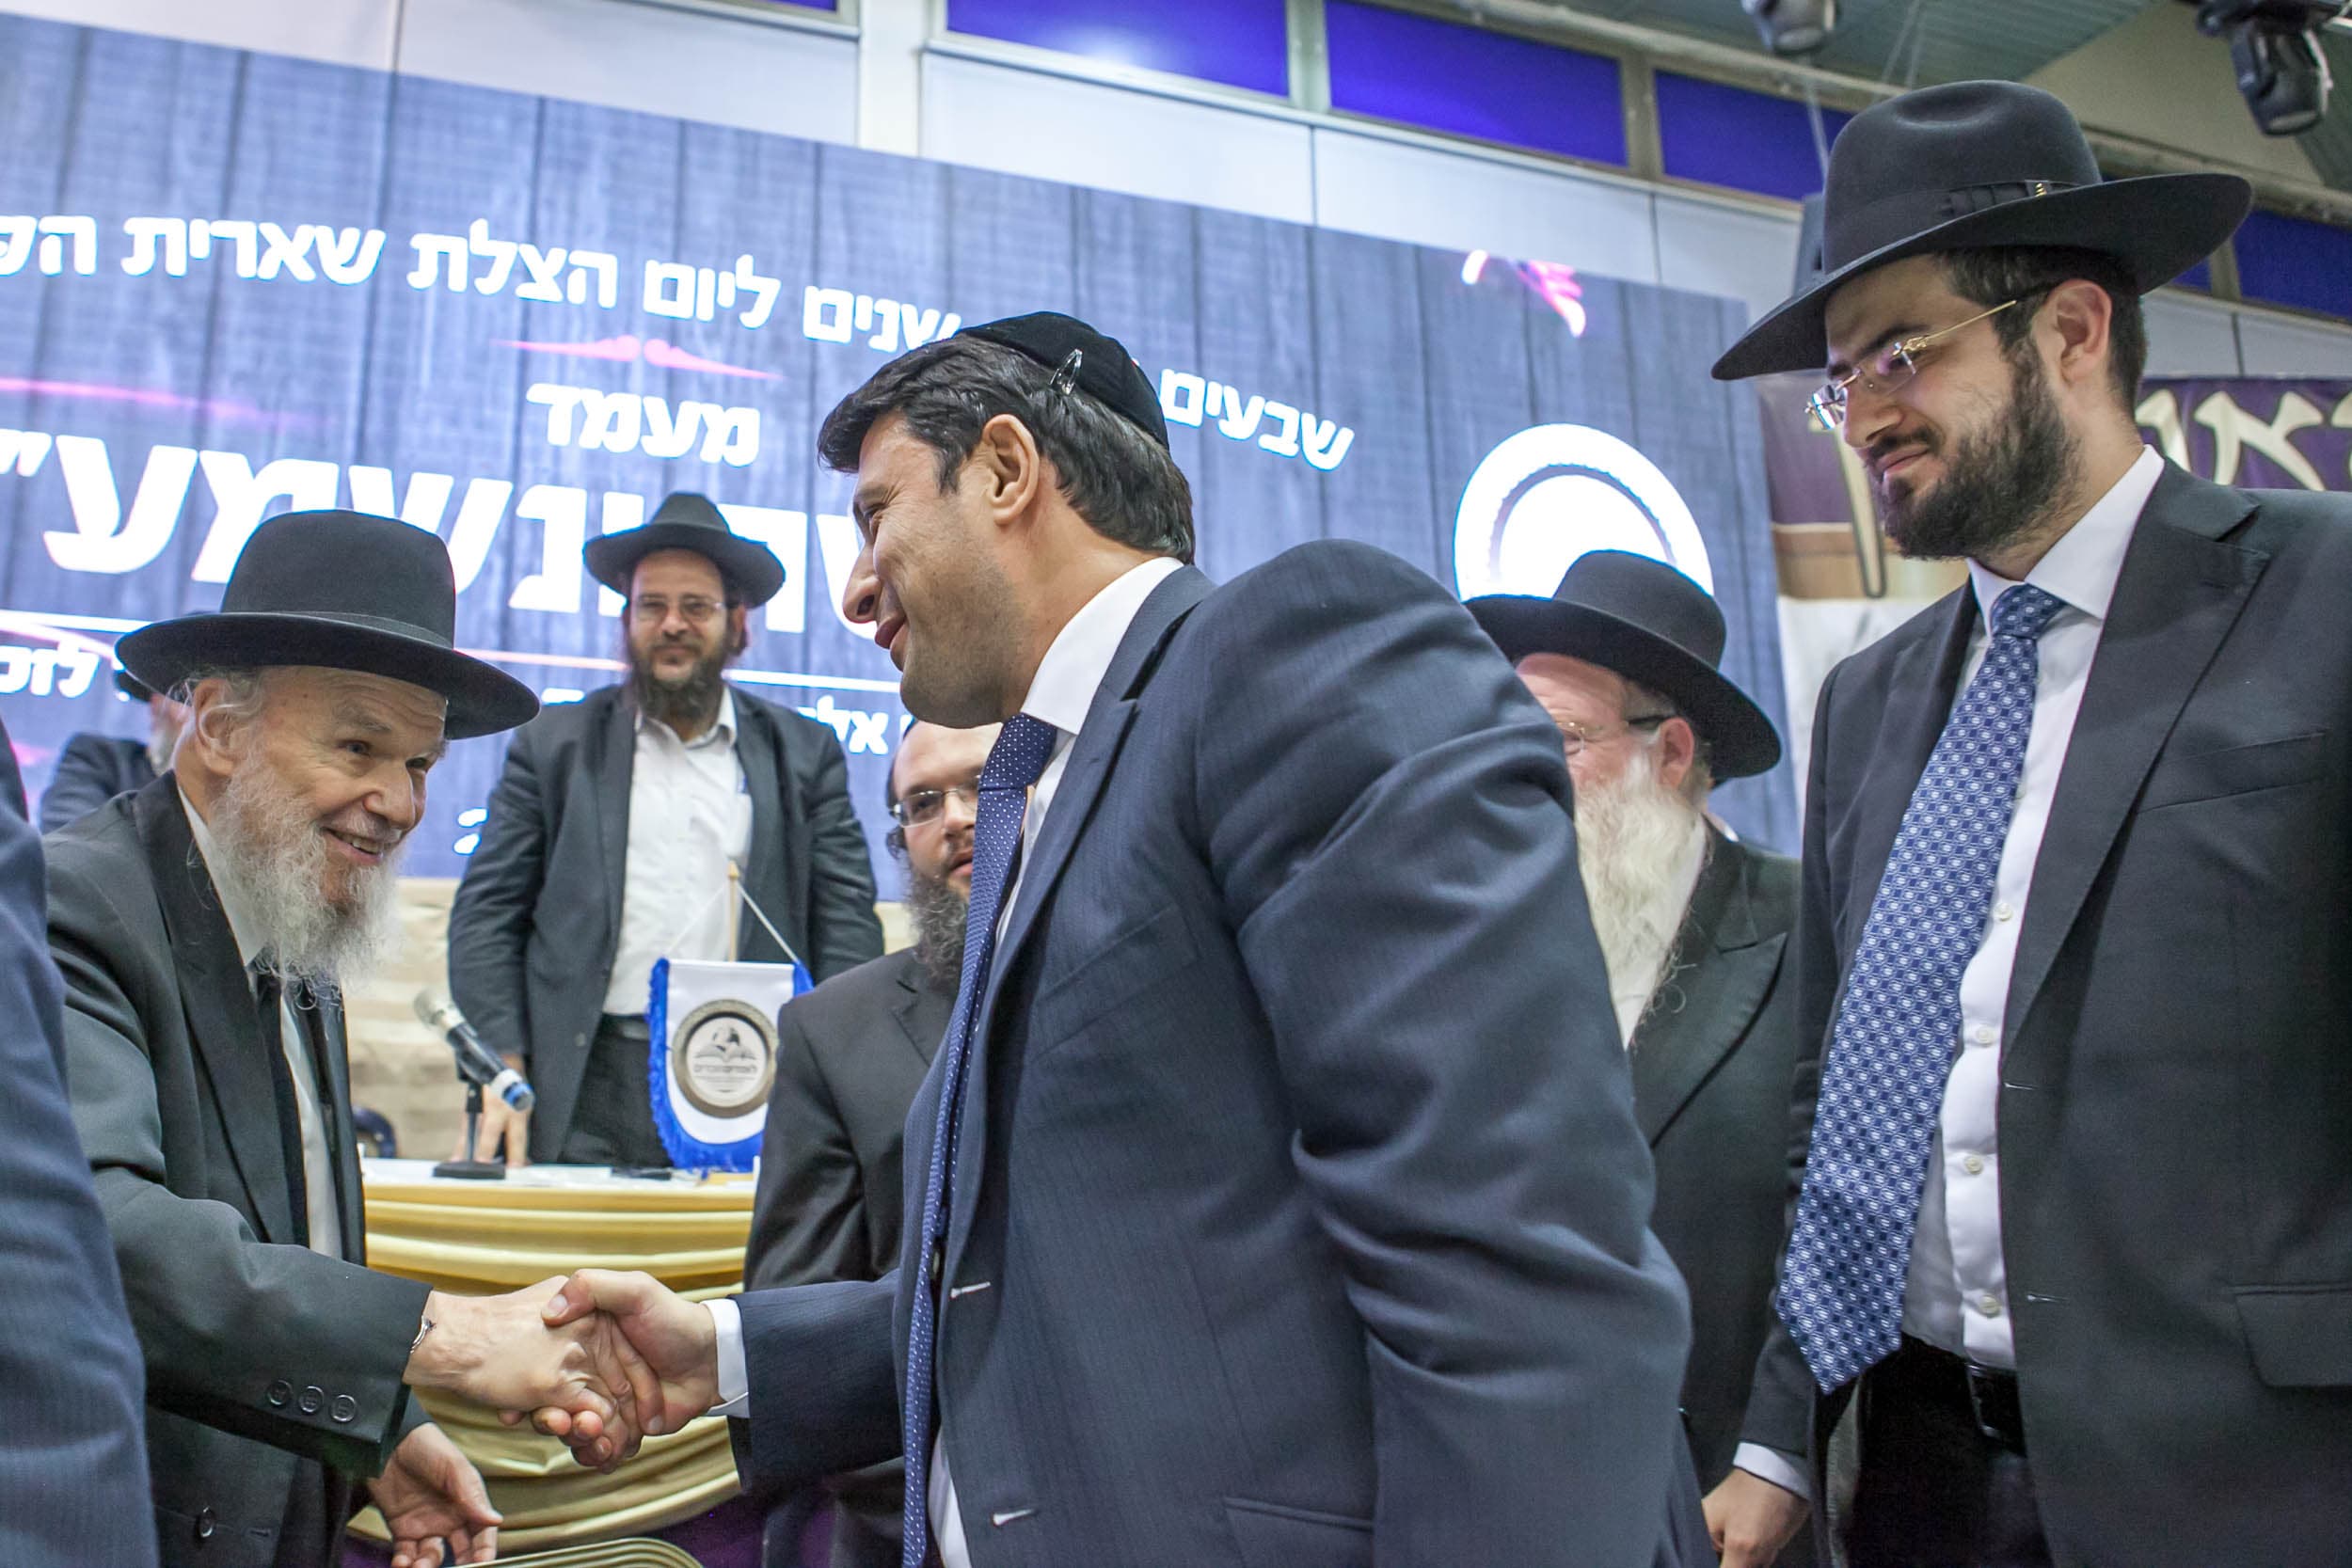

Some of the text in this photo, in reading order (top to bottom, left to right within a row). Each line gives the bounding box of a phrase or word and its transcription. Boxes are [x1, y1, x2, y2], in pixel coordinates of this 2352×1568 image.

[120, 216, 387, 285] שארית
[406, 217, 618, 309] הצלת
[642, 253, 782, 328] ליום
[803, 284, 962, 353] שנים
[525, 382, 761, 467] מעמד
[1159, 368, 1355, 470] שבעים
